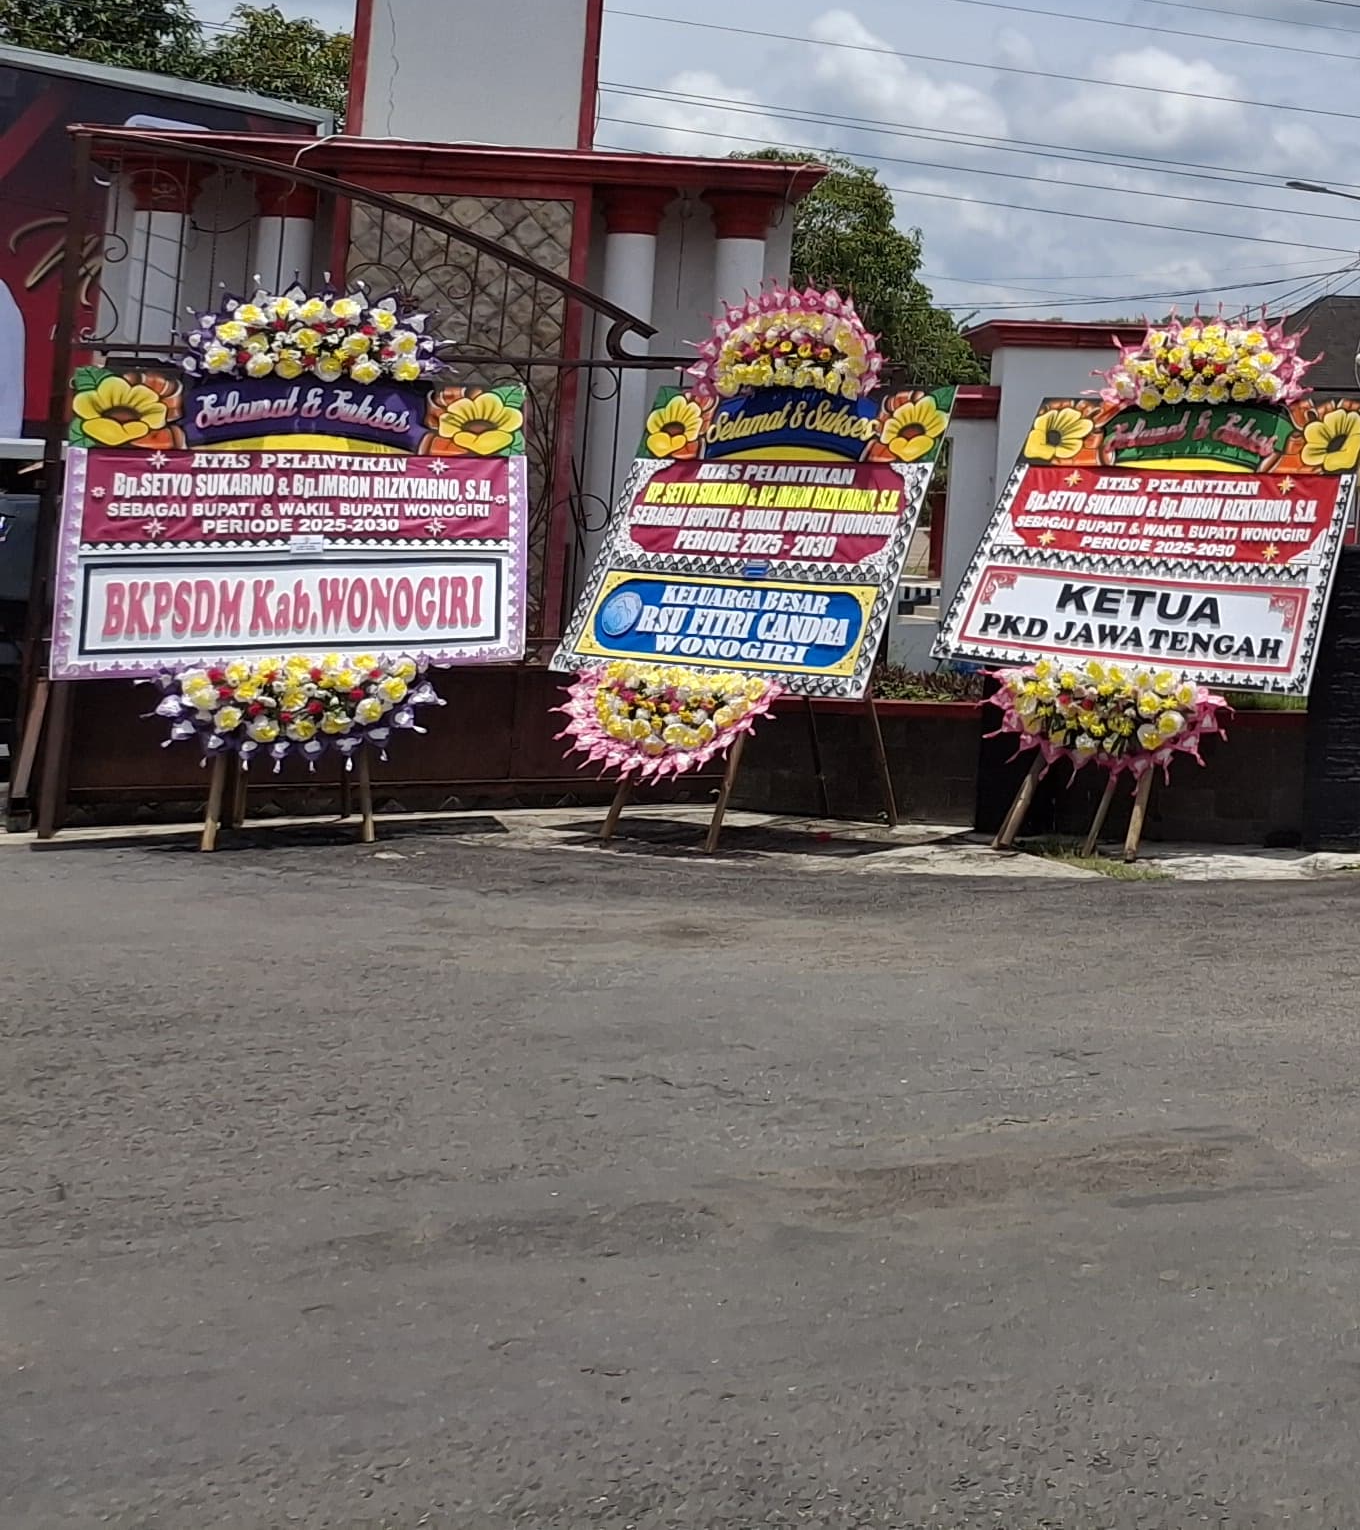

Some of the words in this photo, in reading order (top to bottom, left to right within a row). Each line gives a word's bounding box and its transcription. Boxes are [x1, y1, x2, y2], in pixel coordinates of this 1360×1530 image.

[196, 389, 298, 427] Selamat
[325, 391, 411, 432] Sukses
[707, 402, 789, 442] Selamat
[807, 400, 879, 439] Sukses
[191, 454, 250, 469] ATAS
[261, 454, 407, 472] PELANTIKAN
[696, 464, 741, 479] ATAS
[747, 465, 855, 484] PELANTIKAN
[196, 474, 274, 496] SUKARNO
[466, 479, 494, 501] S.H.
[1095, 477, 1141, 490] ATAS
[1145, 478, 1260, 495] PELANTIKAN
[107, 503, 186, 517] SEBAGAI
[192, 503, 256, 517] BUPATI
[278, 503, 334, 516] WAKIL
[339, 503, 398, 516] BUPATI
[404, 504, 489, 517] WONOGIRI
[629, 506, 686, 526] SEBAGAI
[685, 508, 728, 529] BUPATI
[783, 511, 832, 532] BUPATI
[202, 519, 292, 533] PERIODE
[298, 519, 399, 532] 2025-2030
[1015, 515, 1074, 531] SEBAGAI
[1076, 518, 1125, 533] BUPATI
[1142, 523, 1185, 537] WAKIL
[1188, 525, 1237, 539] BUPATI
[1241, 527, 1310, 541] WONOGIRI
[673, 530, 741, 553] PERIODE
[791, 536, 837, 557] 2030
[1080, 536, 1151, 551] PERIODE
[1154, 541, 1236, 557] 2025-2030
[102, 581, 244, 635] BKPSDM
[661, 585, 762, 609] KELUARGA
[765, 590, 830, 614] BESAR
[1056, 584, 1221, 628] KETUA
[636, 606, 688, 634] RSU
[687, 609, 751, 638] FITRI
[755, 614, 849, 646] CANDRA
[980, 613, 1048, 637] PKD
[654, 636, 809, 662] WONOGIRI
